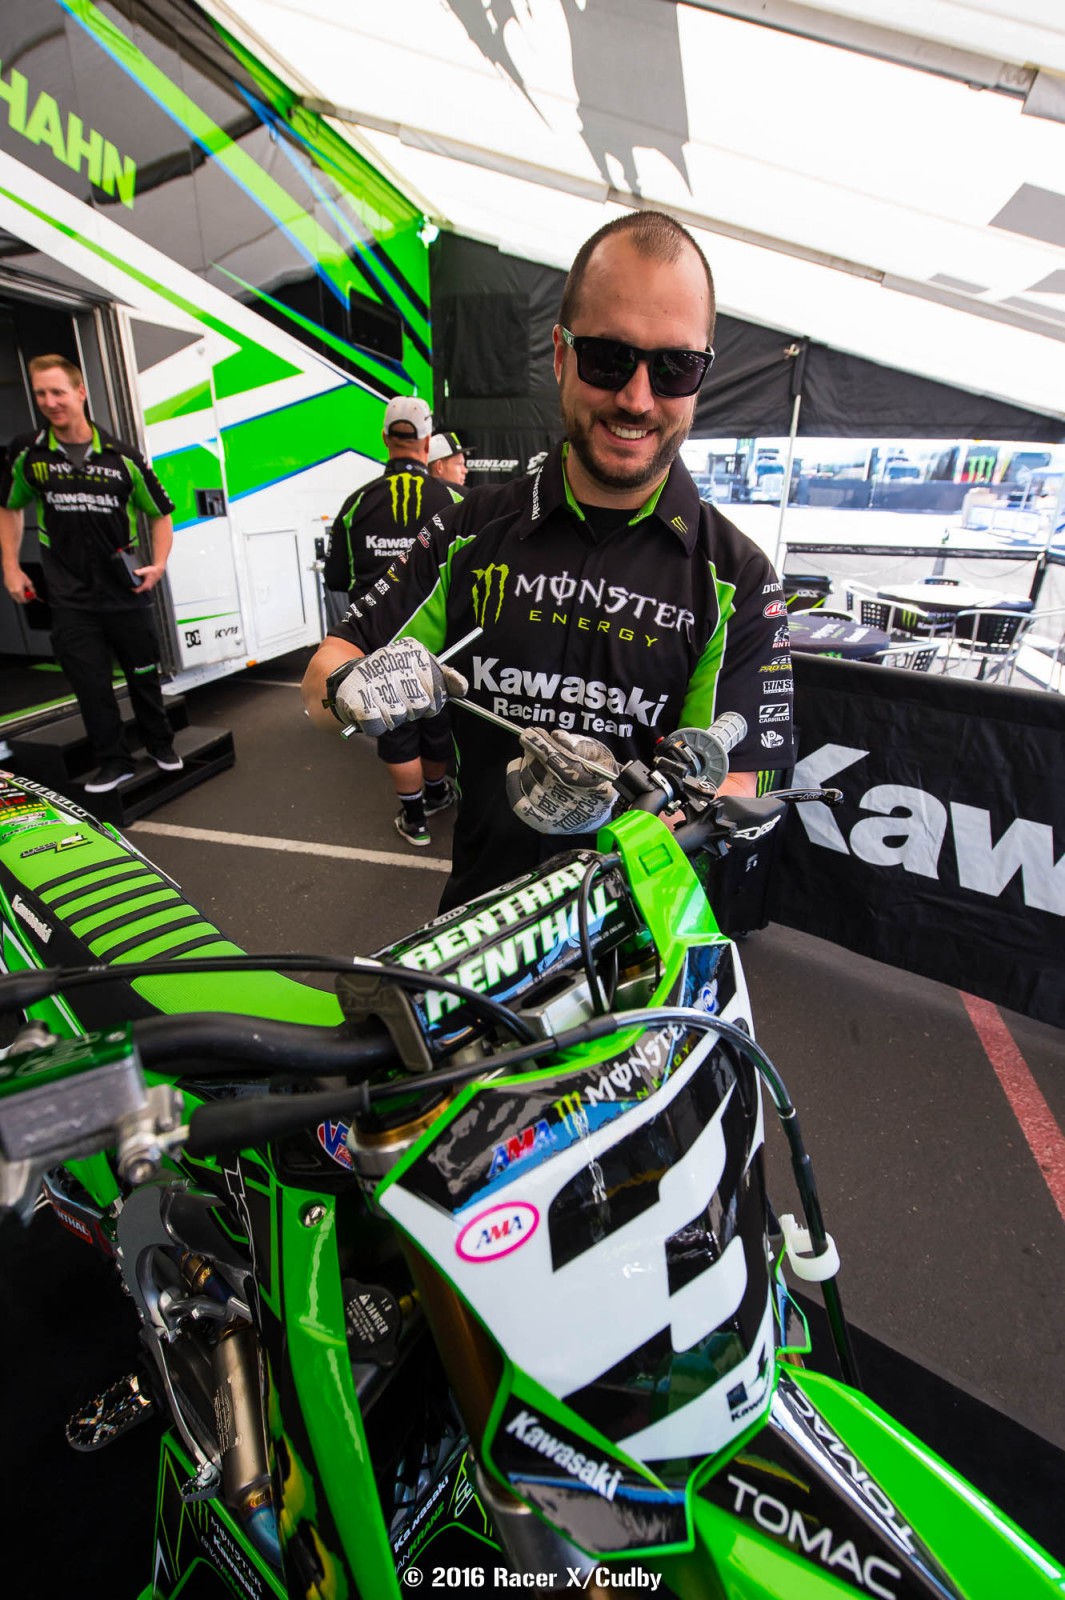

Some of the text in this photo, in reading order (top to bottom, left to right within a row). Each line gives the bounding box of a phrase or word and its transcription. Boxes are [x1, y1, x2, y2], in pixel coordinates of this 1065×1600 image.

[514, 570, 696, 644] MONSTER
[528, 610, 659, 648] ENERGY
[472, 655, 669, 728] Kawasaki
[493, 695, 634, 739] Racing Team
[487, 1119, 556, 1178] AMA
[475, 1214, 523, 1251] AMA
[365, 1301, 389, 1335] DANGER
[506, 1410, 625, 1502] Kawasaki
[785, 1388, 917, 1556] TOMAC
[393, 1474, 449, 1553] Kawasaki
[727, 1474, 902, 1600] TOMAC
